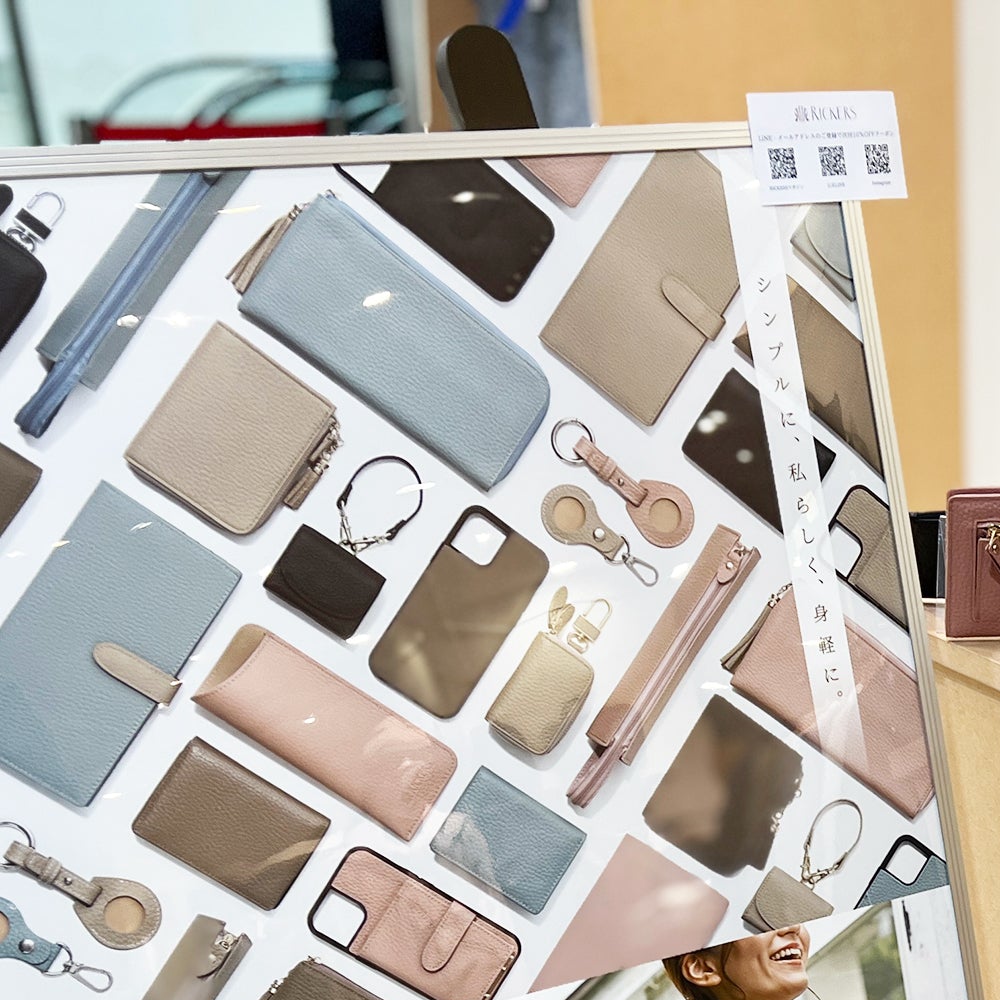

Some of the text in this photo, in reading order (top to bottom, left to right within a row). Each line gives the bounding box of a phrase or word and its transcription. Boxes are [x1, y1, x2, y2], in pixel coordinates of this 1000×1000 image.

[810, 105, 857, 121] RICKERS
[756, 277, 843, 698] シンプルに、私らしく、身軽に。
